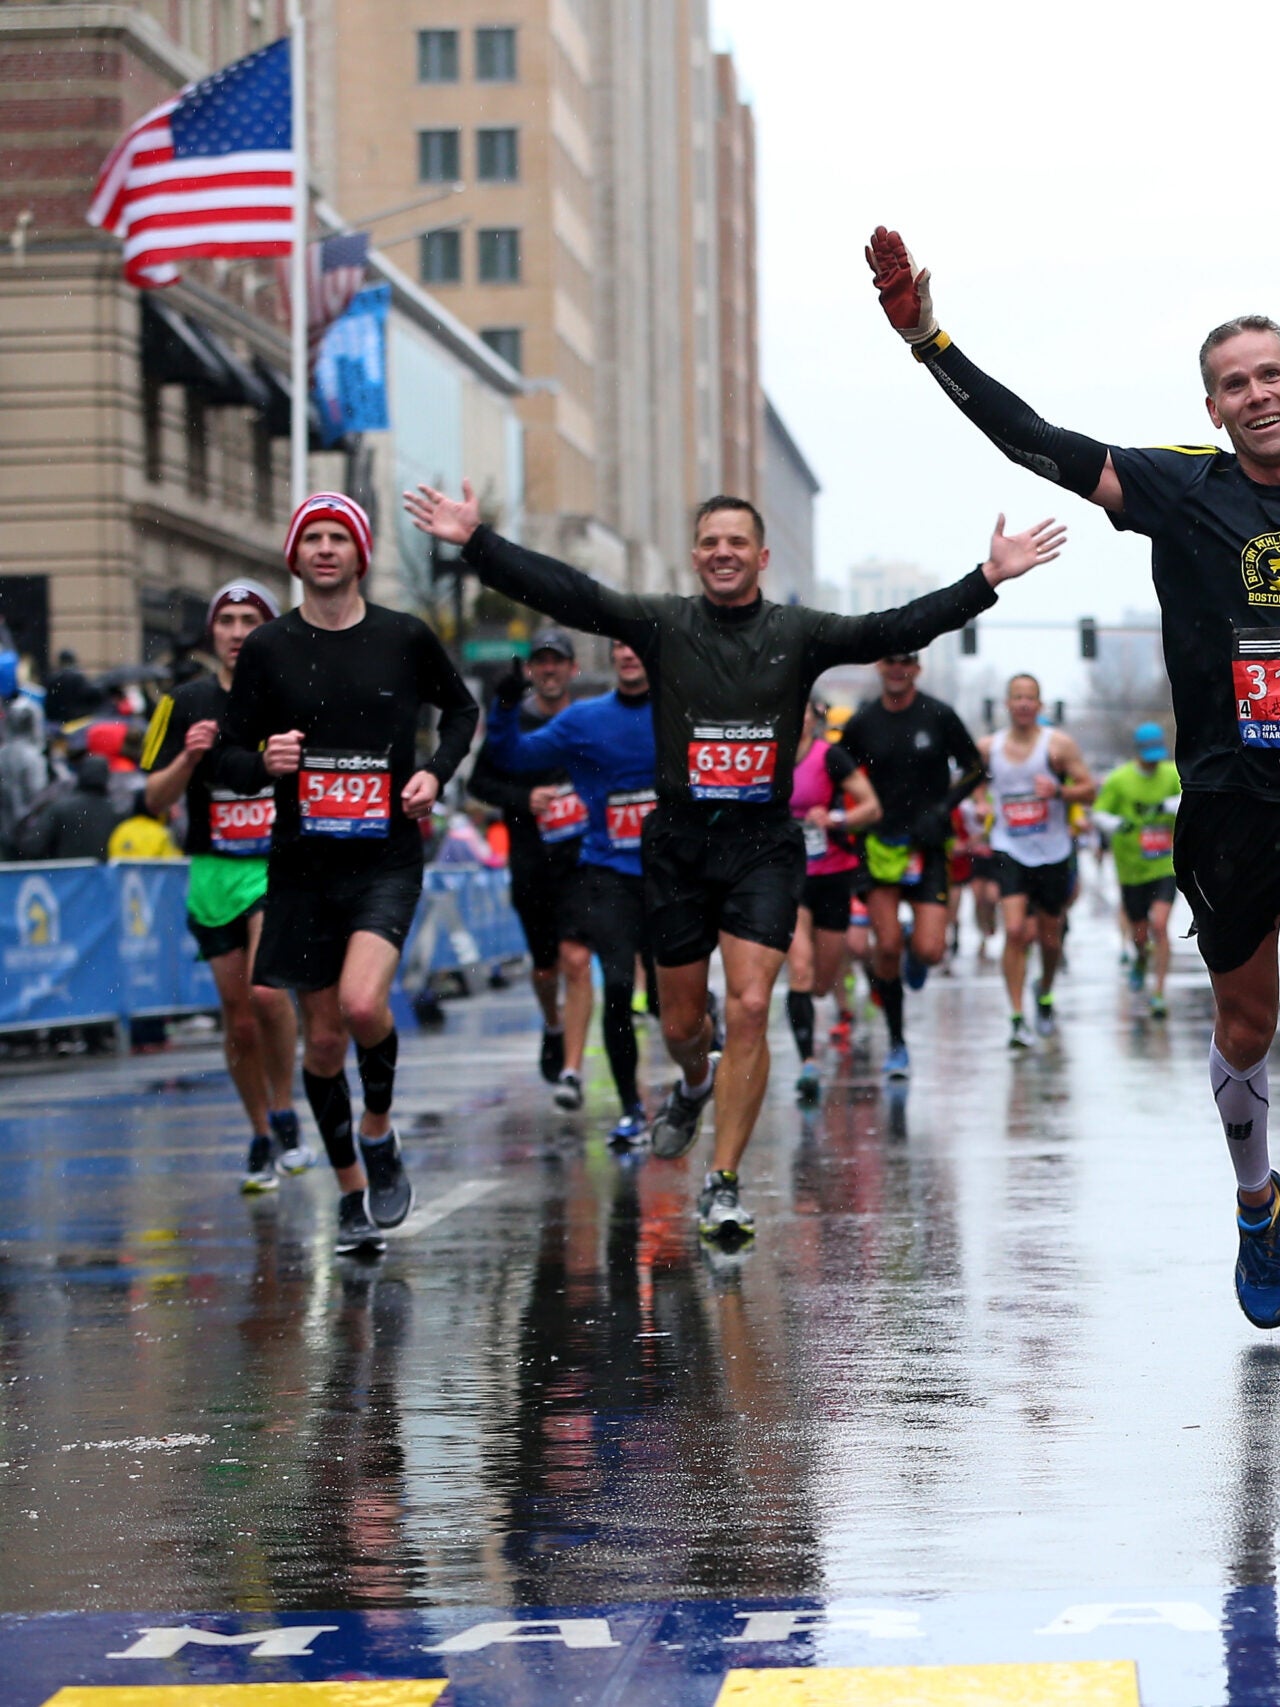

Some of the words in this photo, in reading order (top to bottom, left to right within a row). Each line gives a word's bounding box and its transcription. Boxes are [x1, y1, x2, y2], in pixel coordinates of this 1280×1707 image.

[1241, 700, 1251, 718] 4
[725, 726, 774, 739] adidas
[1262, 723, 1277, 732] 2015
[337, 755, 388, 770] adidas
[697, 745, 770, 771] 6367
[308, 775, 383, 803] 5492
